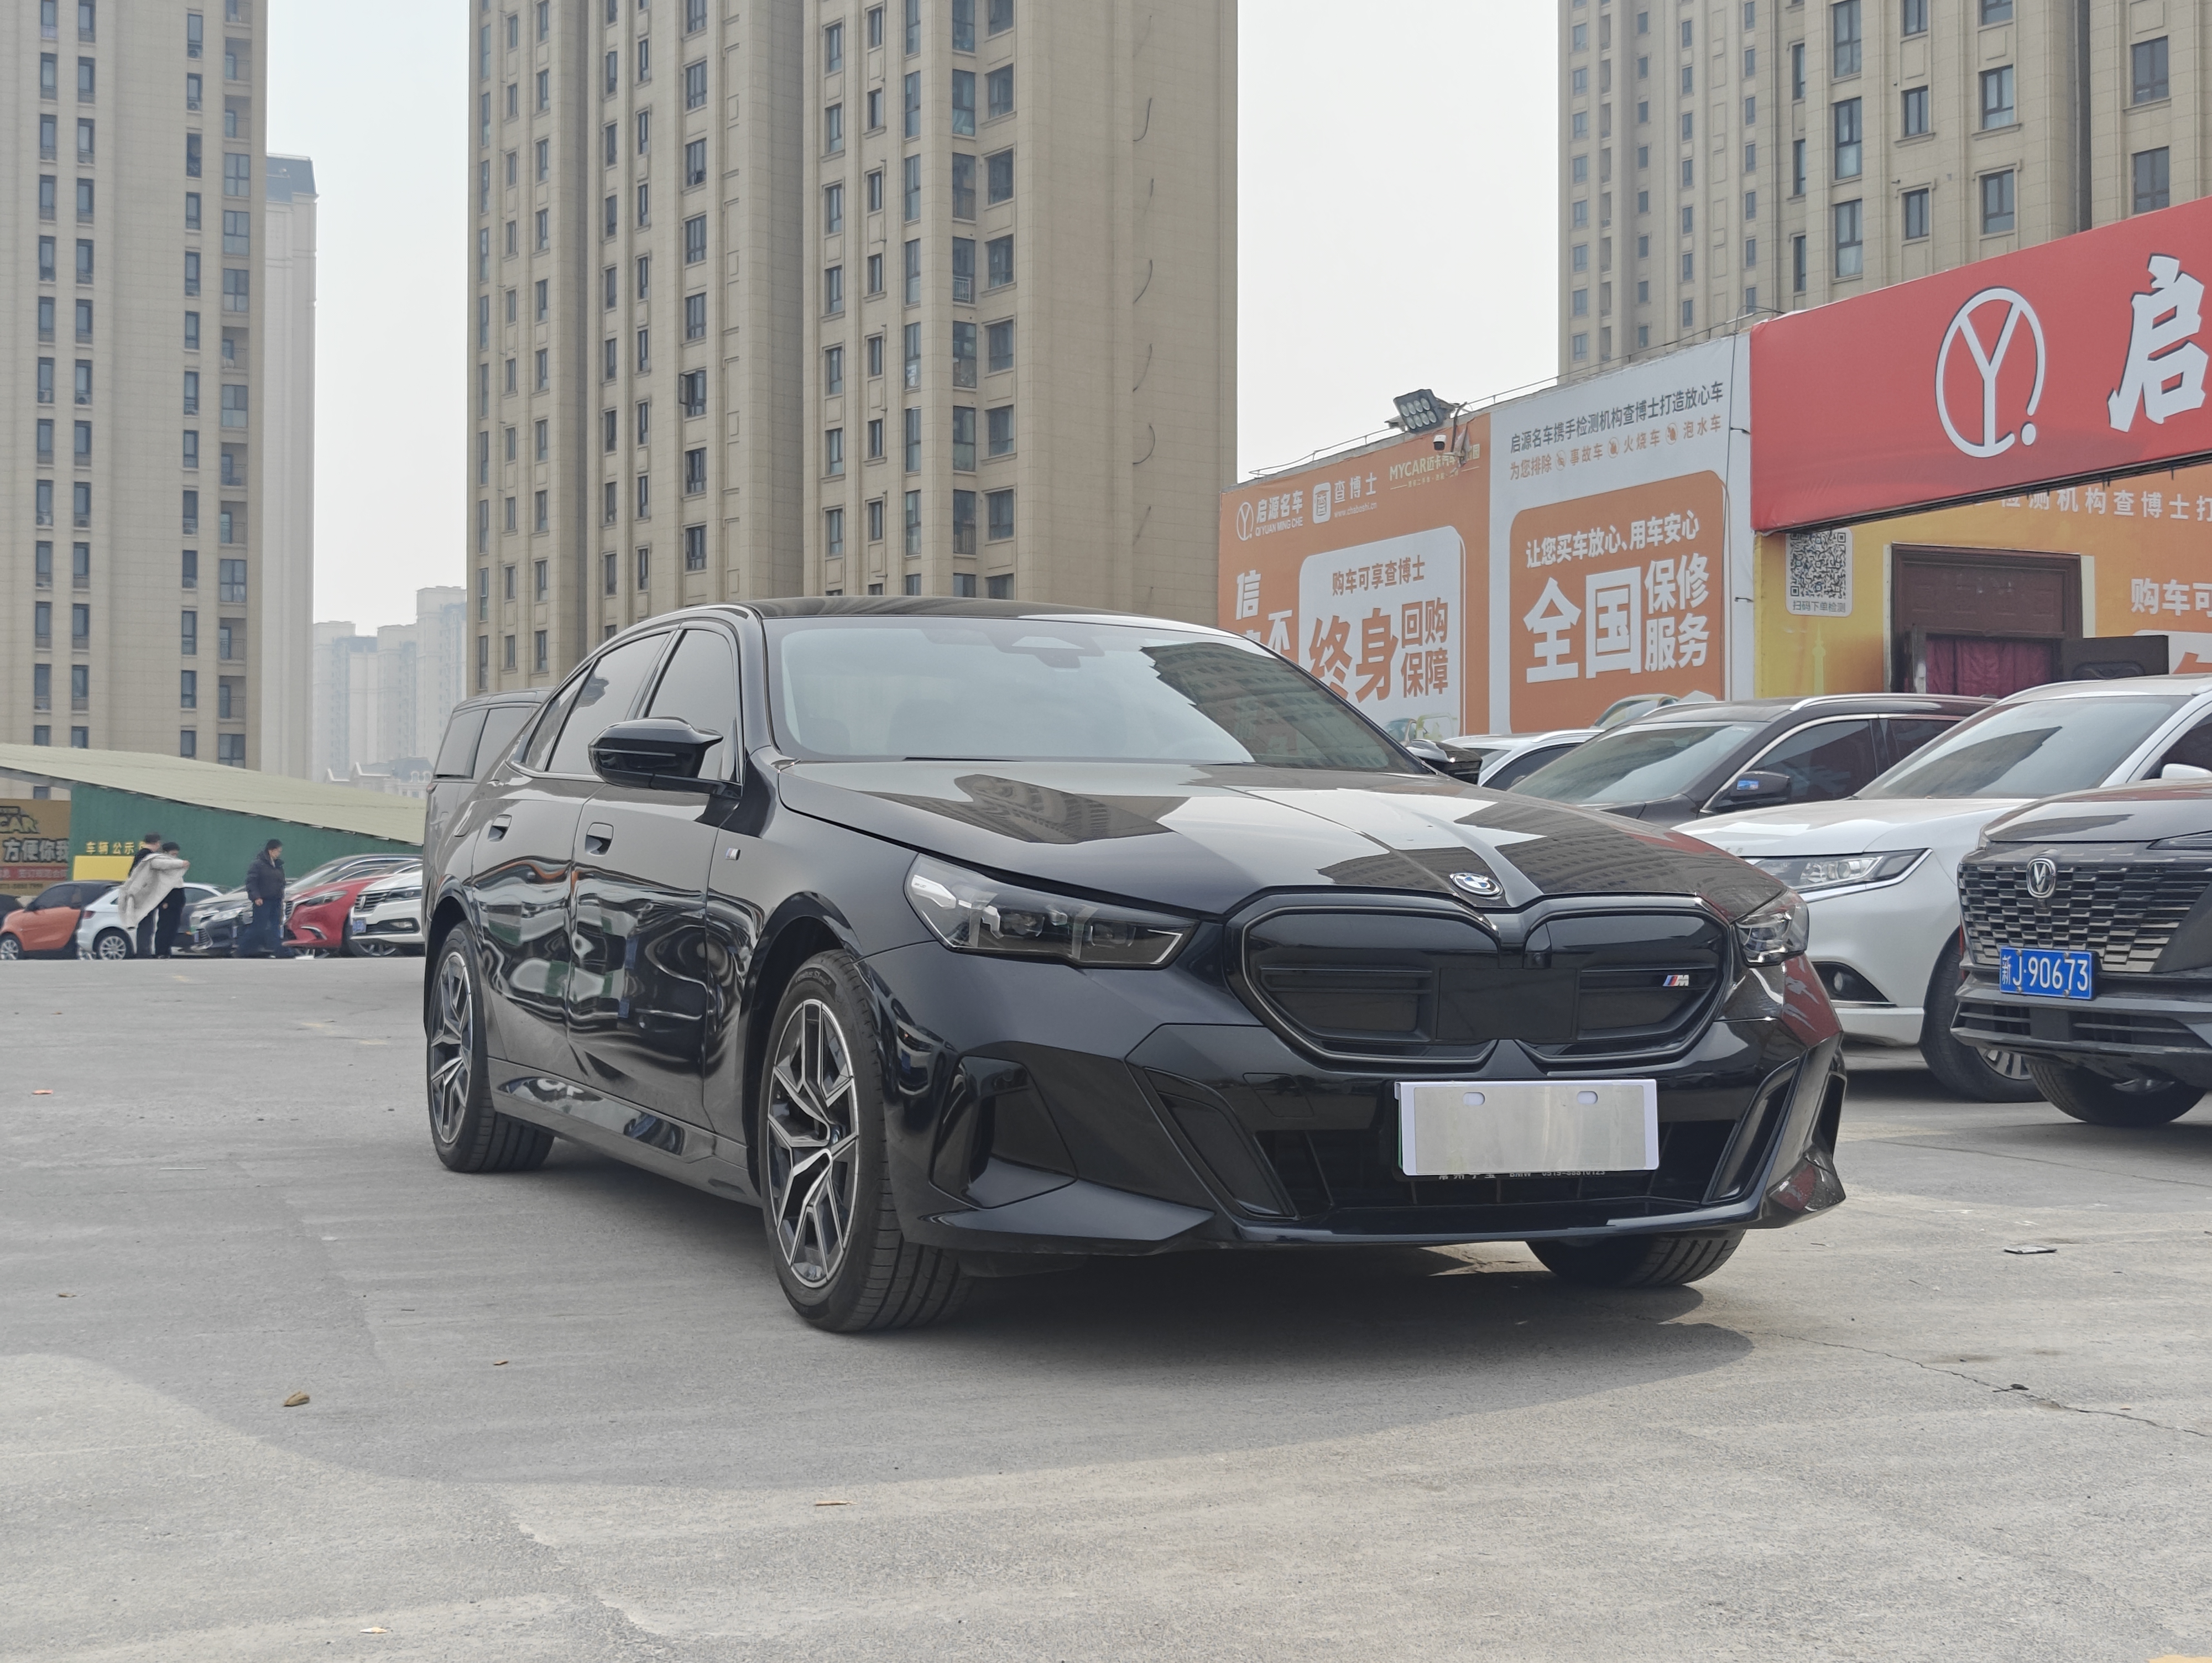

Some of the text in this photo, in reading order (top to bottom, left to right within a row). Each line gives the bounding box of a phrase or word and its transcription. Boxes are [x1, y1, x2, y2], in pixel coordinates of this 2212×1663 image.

[2108, 254, 2209, 432] 启
[1510, 381, 1723, 453] 启源名车携手检测机构查博士打造放心车
[1510, 415, 1721, 480] 为您排除 事故车 火烧车 泡水车
[1257, 490, 1303, 524] 启源名车
[1334, 472, 1377, 504] 查博士
[1255, 516, 1303, 537] QIYUAN MING CHE
[1526, 510, 1700, 569] 让您买车放心、用车安心
[1332, 555, 1425, 596] 购车可享查博士
[1523, 553, 1709, 683] 全国 保修
[1793, 600, 1846, 613] 扫码下单检测
[1308, 597, 1448, 703] 终身 回购
[1645, 613, 1709, 672] 服务
[1401, 647, 1448, 698] 保障
